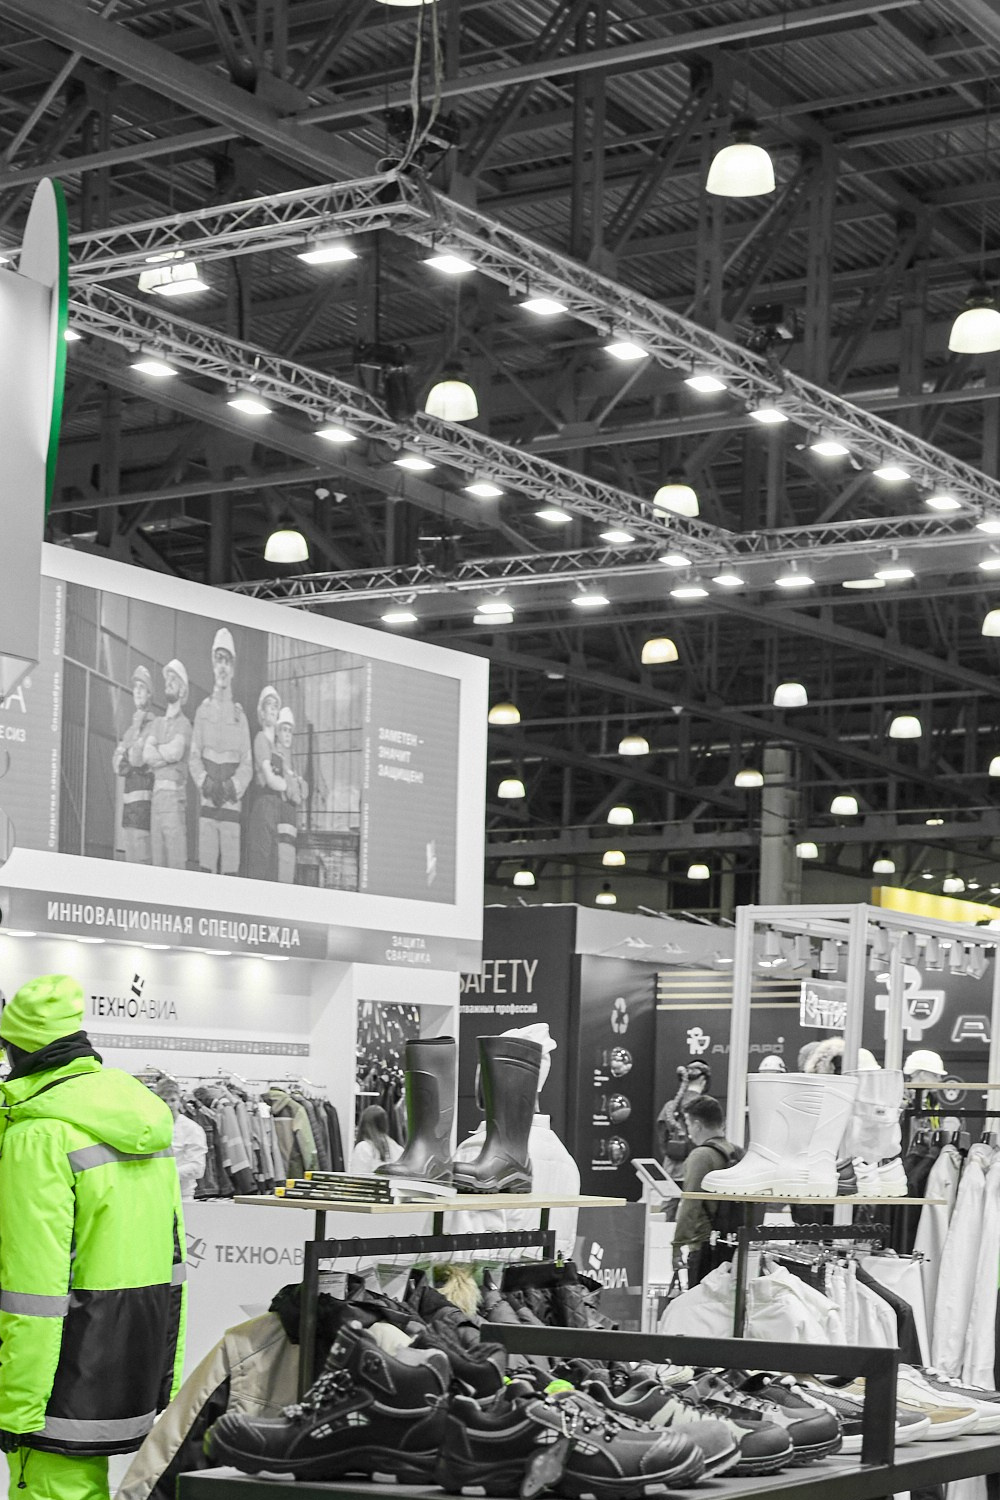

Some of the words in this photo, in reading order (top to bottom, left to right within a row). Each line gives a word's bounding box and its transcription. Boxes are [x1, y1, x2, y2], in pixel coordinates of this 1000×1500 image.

[47, 901, 193, 934] ИННОВАЦИОННАЯ
[198, 917, 301, 948] СПЕЦОДЕЖДА
[391, 935, 425, 950] ЗАЩИТА
[385, 949, 431, 964] СВАРЩИКА
[91, 995, 178, 1020] ТЕХНОАВИА
[215, 1245, 333, 1272] ТЕХНОАВ
